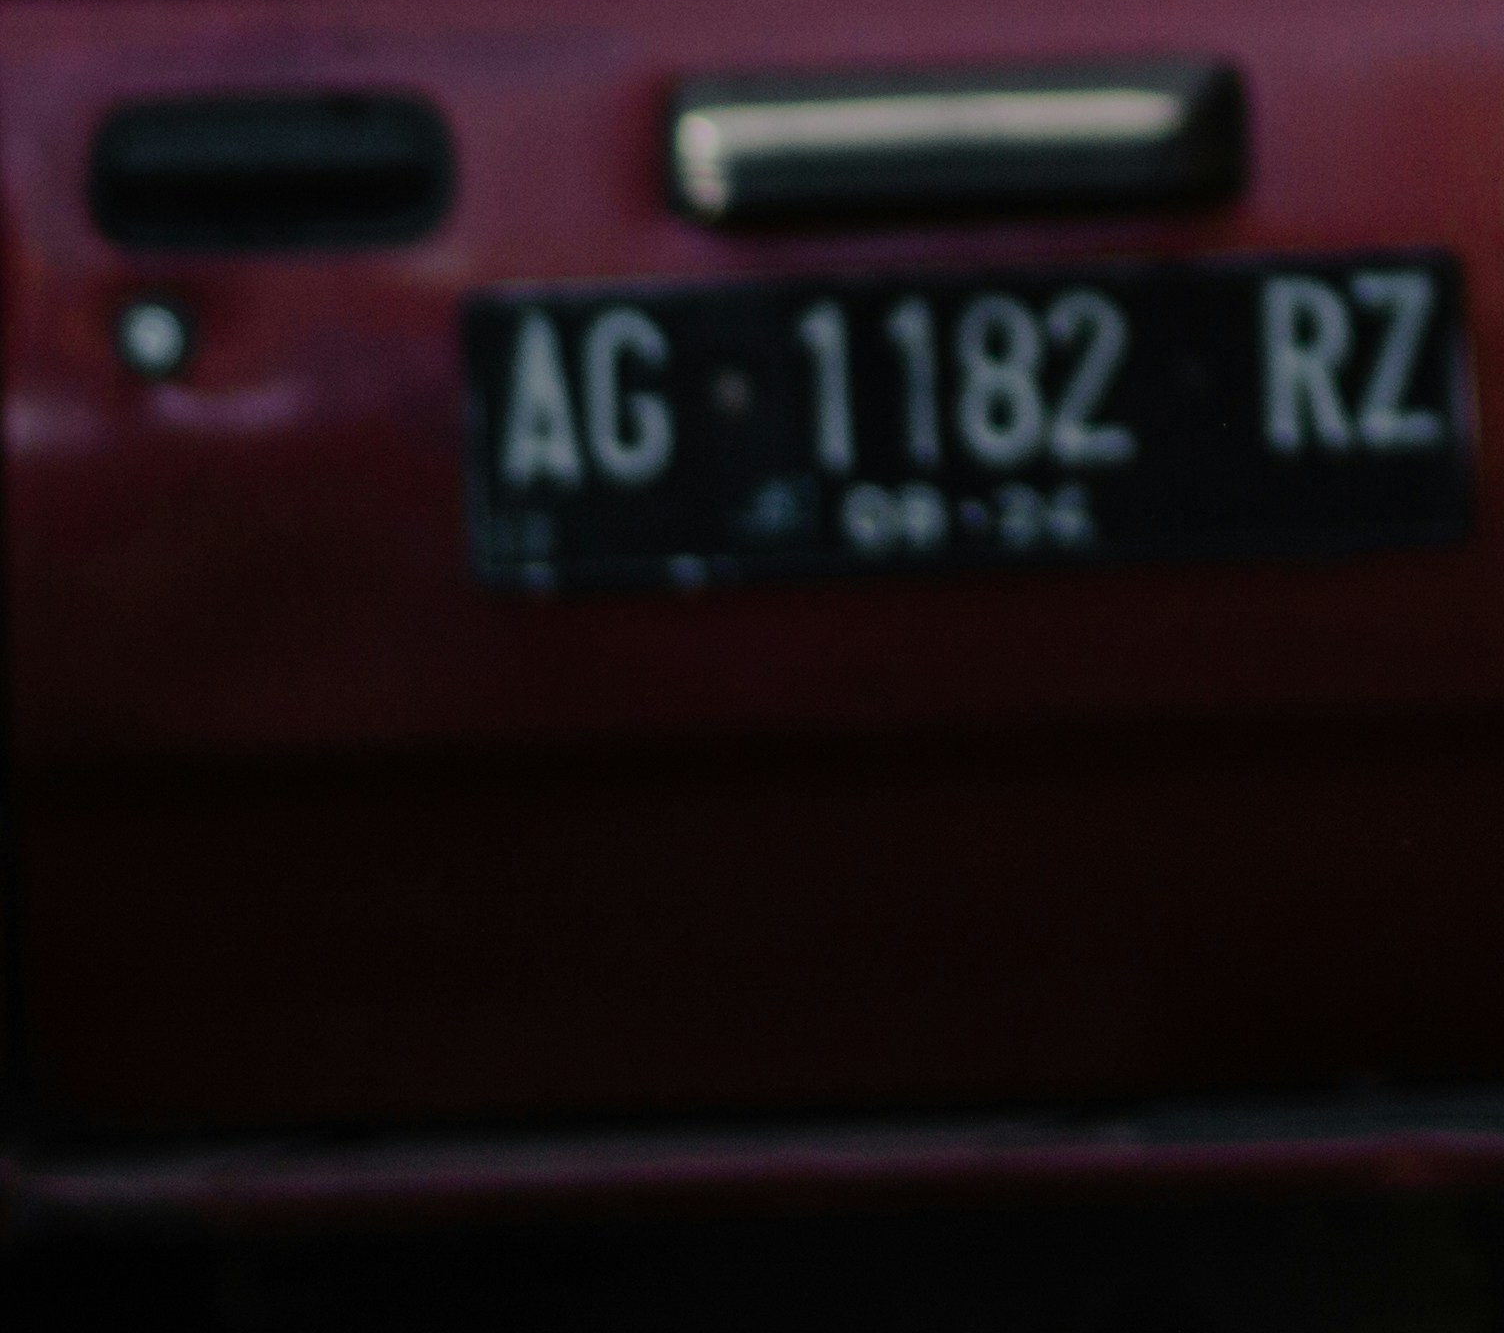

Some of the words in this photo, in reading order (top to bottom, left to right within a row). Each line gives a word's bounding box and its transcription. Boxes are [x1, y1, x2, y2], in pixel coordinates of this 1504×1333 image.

[500, 307, 676, 485] AG
[796, 286, 1136, 469] 1182
[1260, 271, 1444, 451] RZ
